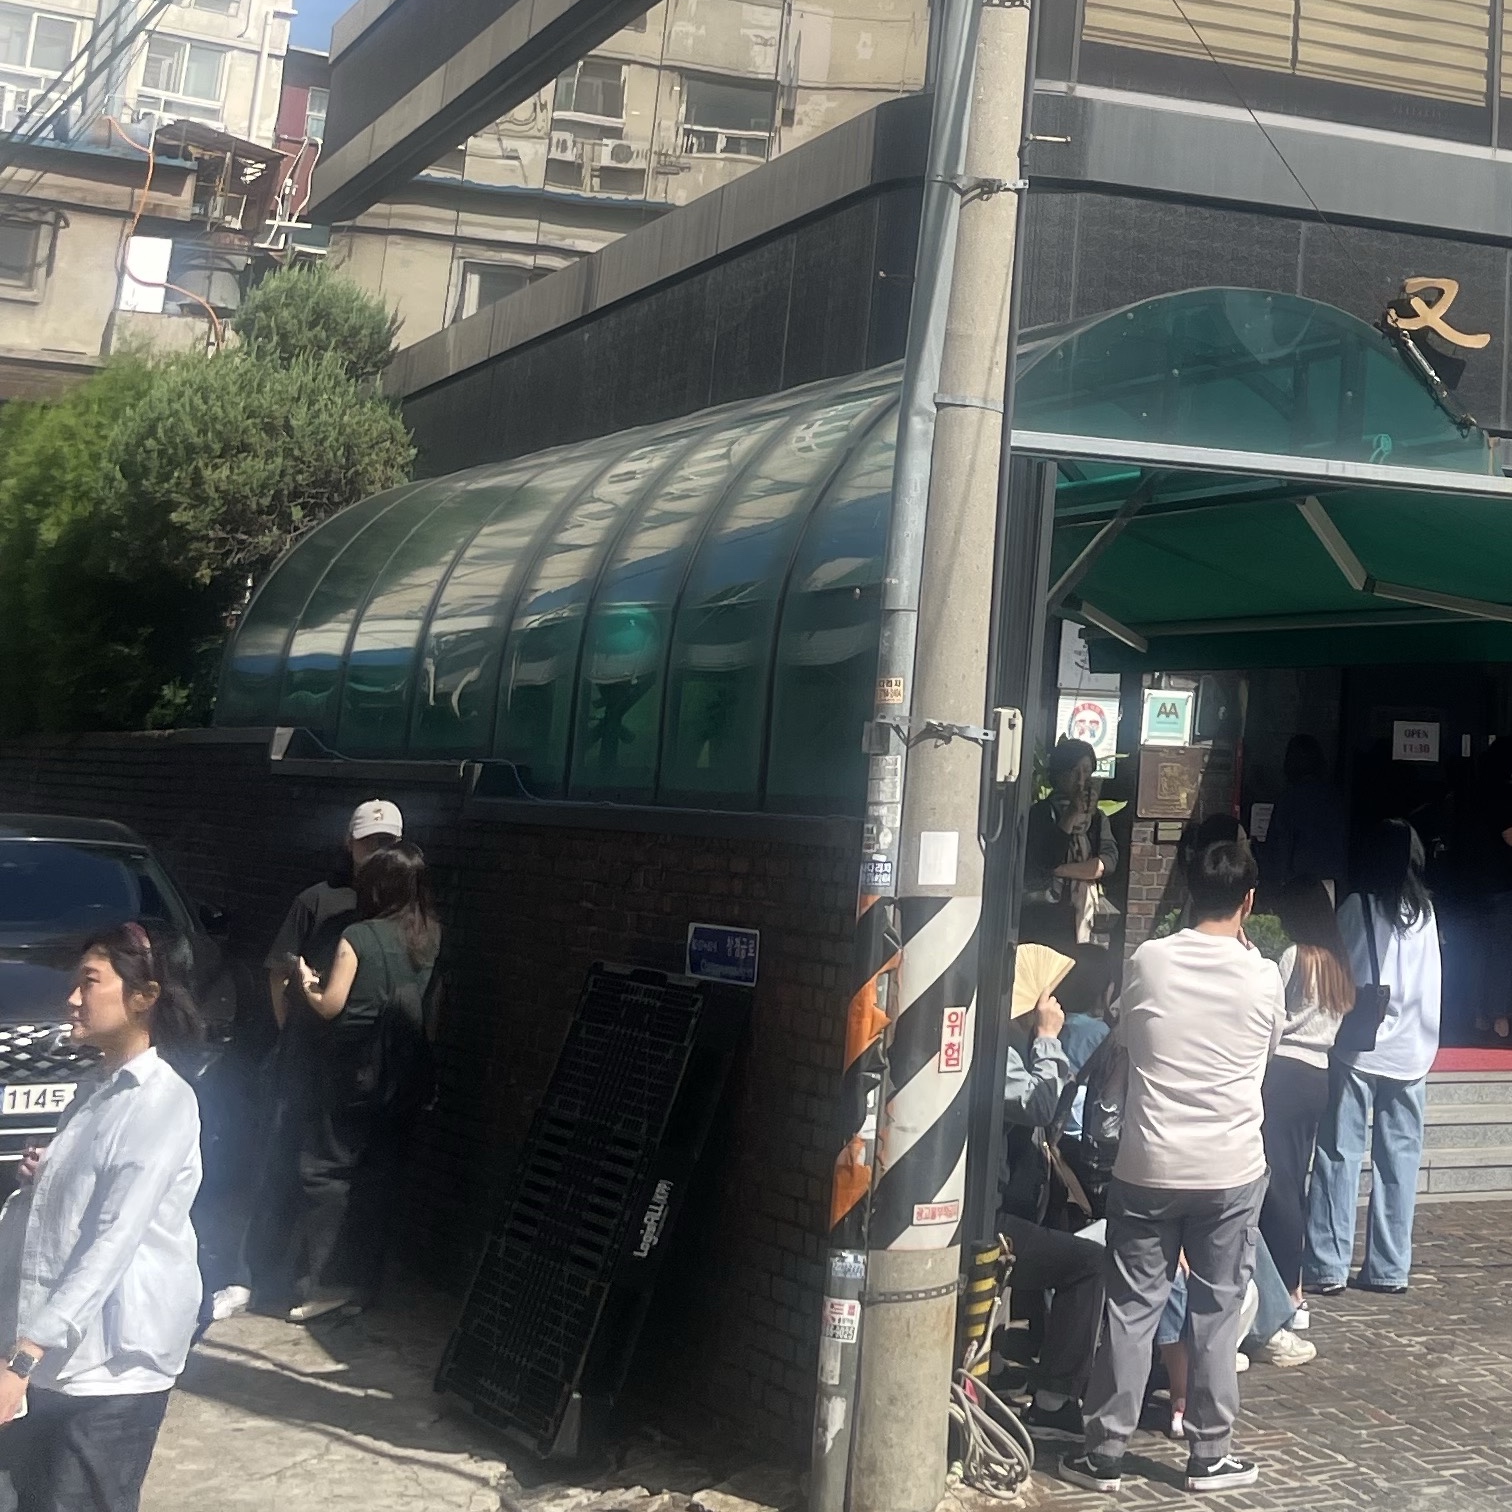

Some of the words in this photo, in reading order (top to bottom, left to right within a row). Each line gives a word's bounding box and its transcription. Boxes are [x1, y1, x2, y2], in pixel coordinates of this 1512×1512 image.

[1157, 702, 1179, 719] AA
[1404, 728, 1429, 739] OPEN
[944, 1011, 964, 1068] 위험
[8, 1088, 66, 1110] 114두
